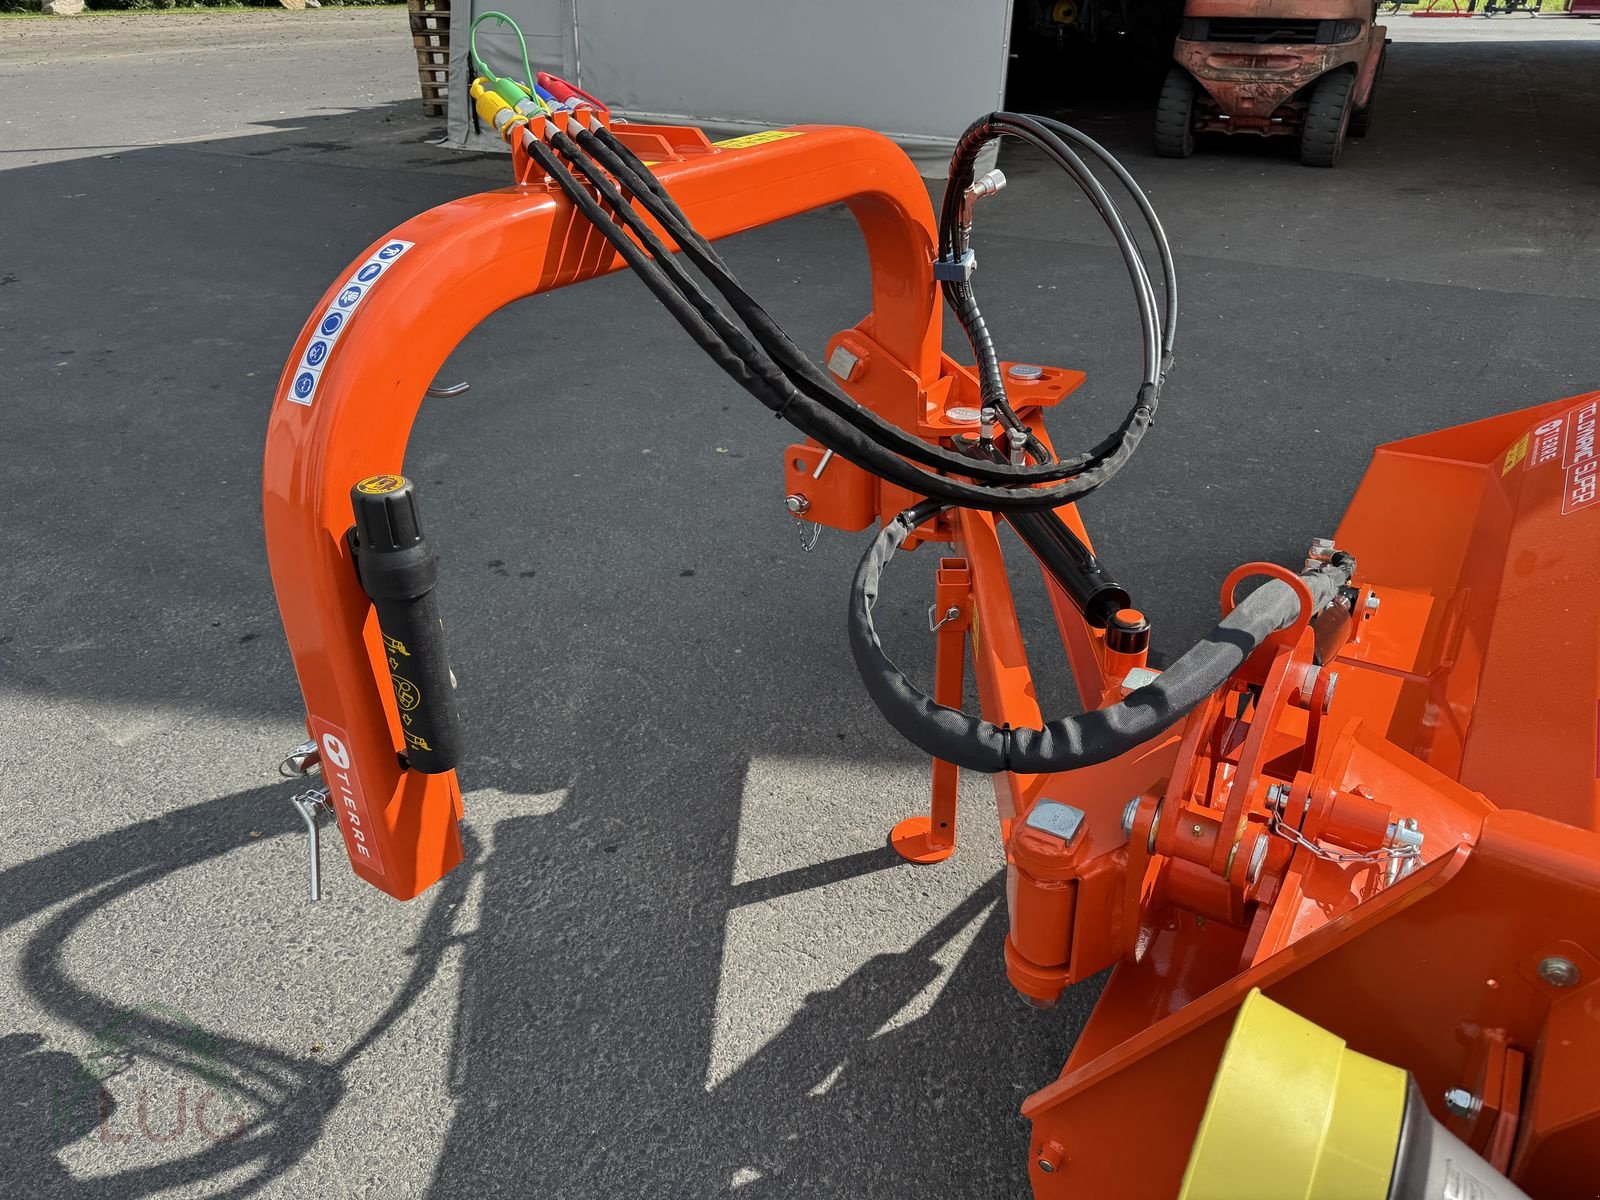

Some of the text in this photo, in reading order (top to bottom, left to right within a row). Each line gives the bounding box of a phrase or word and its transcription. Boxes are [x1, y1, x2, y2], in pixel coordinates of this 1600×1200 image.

[1540, 426, 1559, 463] TIERRE
[1573, 460, 1597, 506] SUPER
[337, 772, 370, 858] TIERRE
